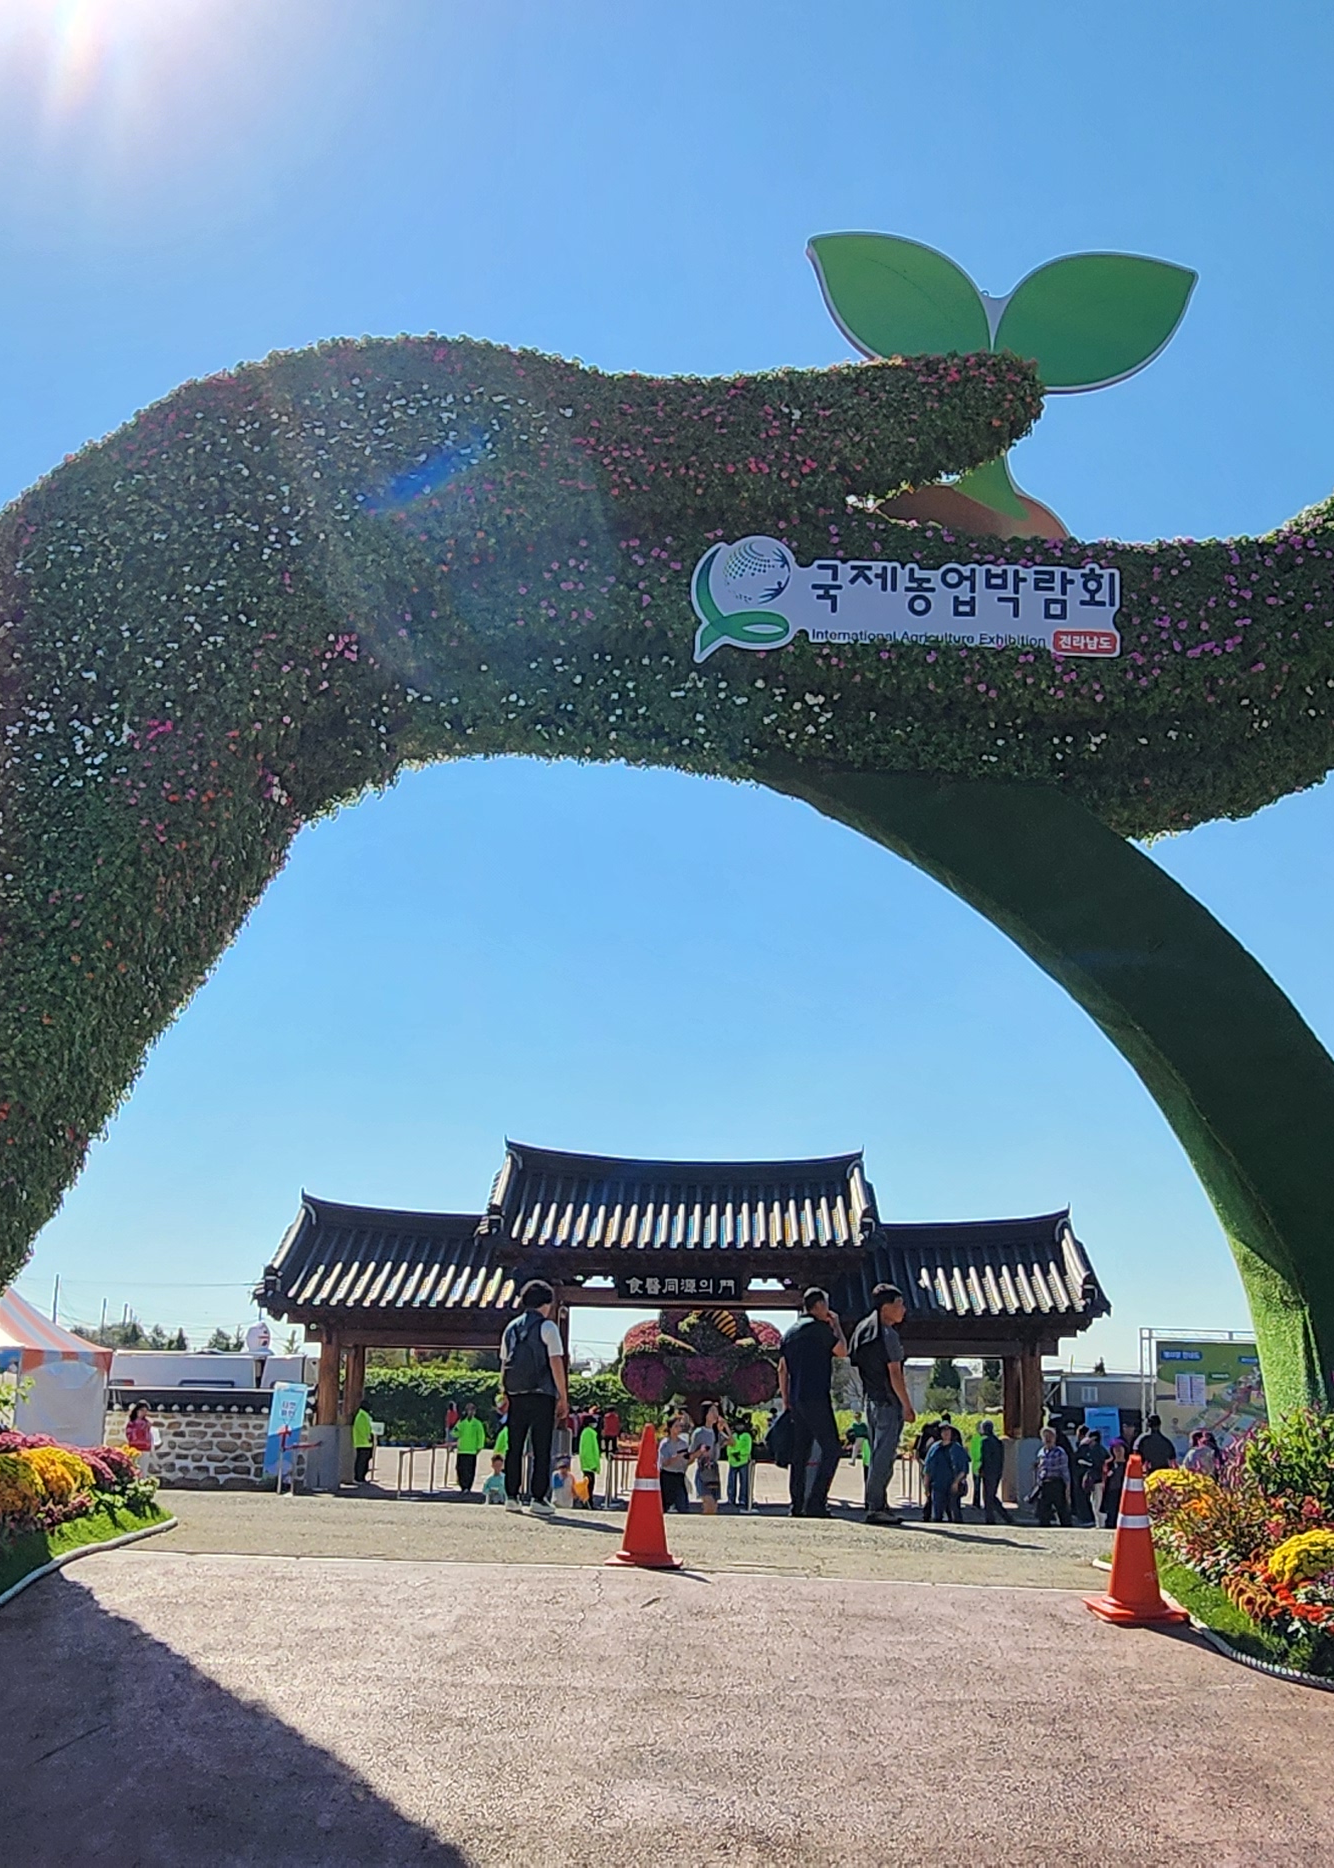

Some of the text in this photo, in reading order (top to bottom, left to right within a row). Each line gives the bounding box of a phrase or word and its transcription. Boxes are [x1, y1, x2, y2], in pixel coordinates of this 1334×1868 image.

[810, 563, 1116, 620] 국제농업박람회
[812, 628, 897, 642] International
[979, 632, 1046, 649] Exhibition
[1058, 633, 1113, 651] 전라남도
